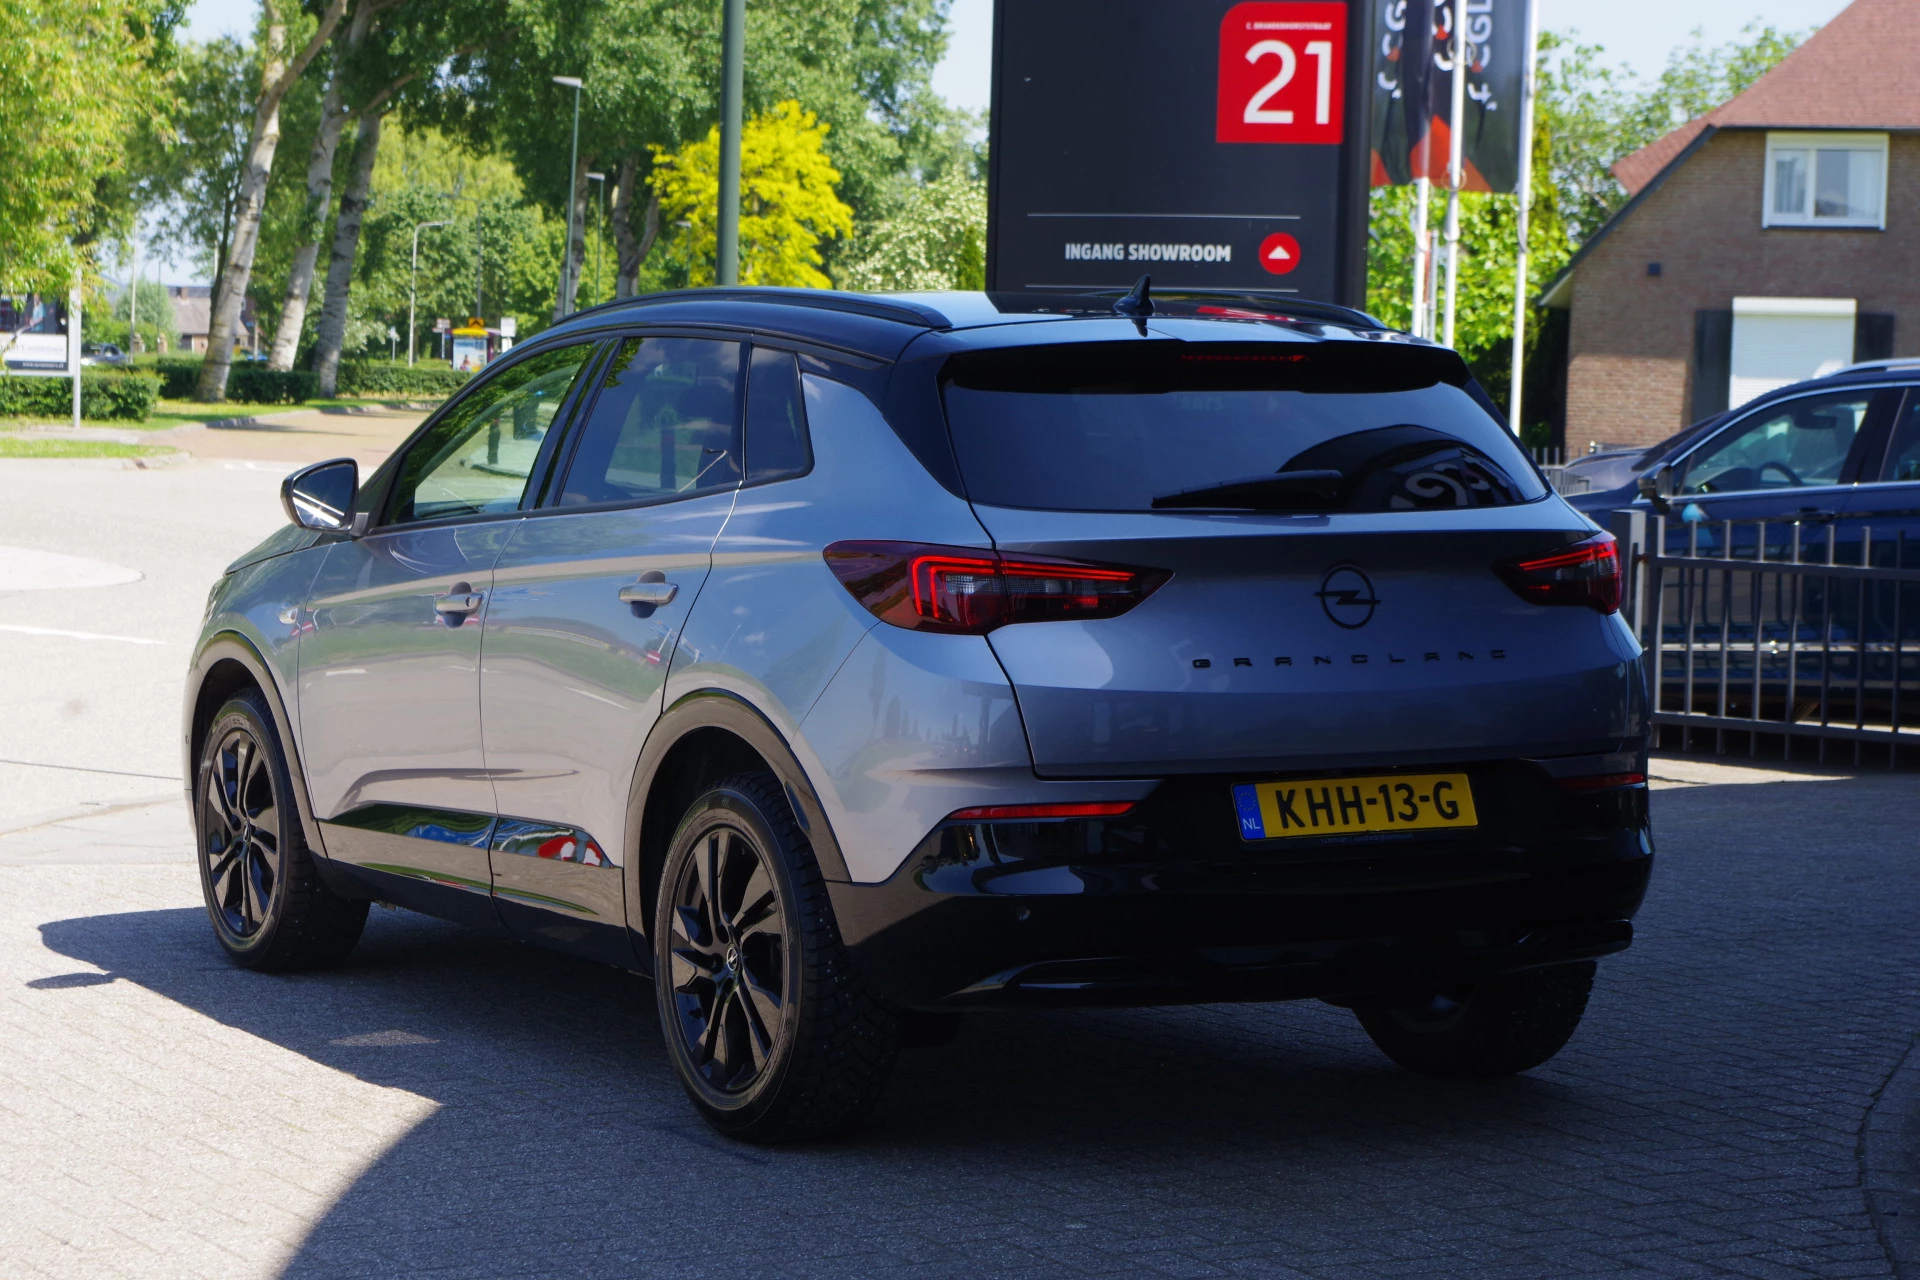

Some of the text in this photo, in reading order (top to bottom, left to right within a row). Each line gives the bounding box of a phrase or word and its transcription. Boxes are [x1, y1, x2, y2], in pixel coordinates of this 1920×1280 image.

[1243, 39, 1332, 125] 21
[1065, 242, 1231, 262] INGANG SHOWROOM
[1192, 649, 1507, 669] GRANDLAND
[1274, 780, 1460, 830] KHH-13-G
[1242, 818, 1261, 830] NL
